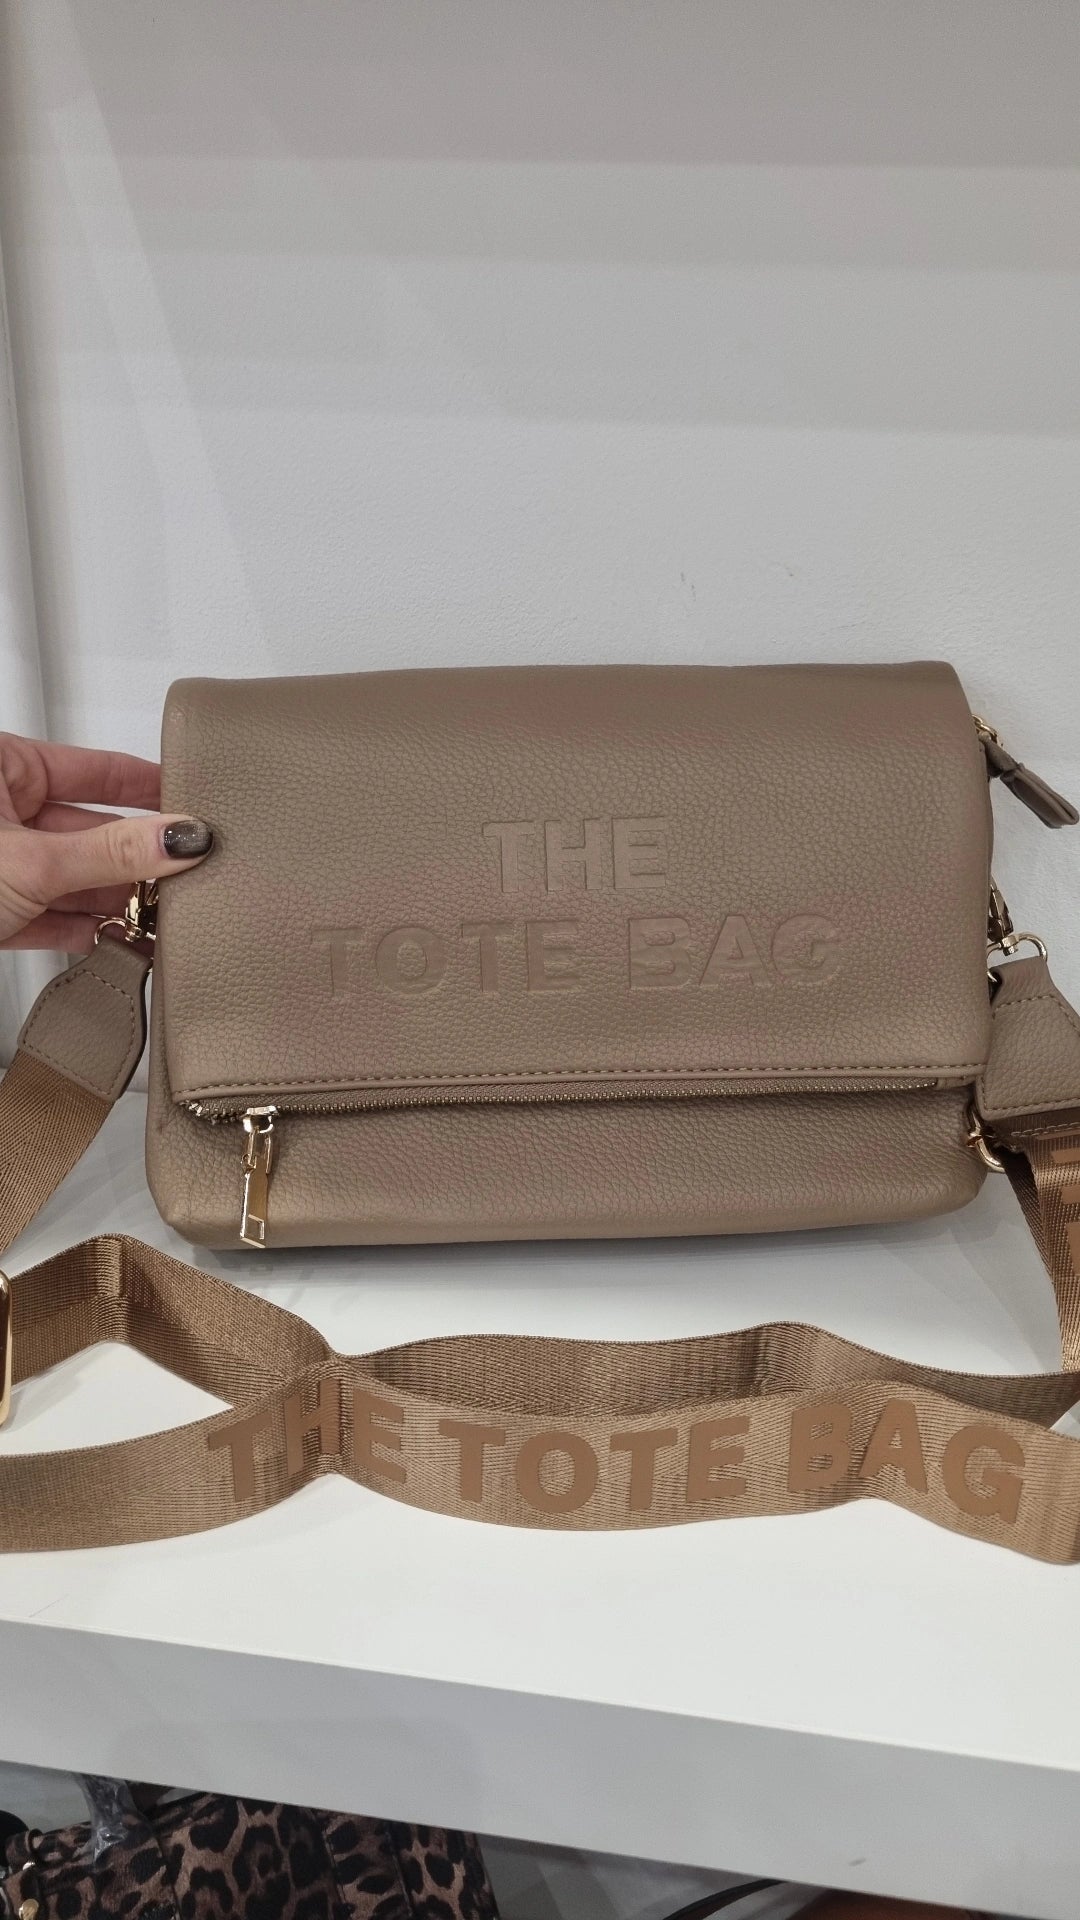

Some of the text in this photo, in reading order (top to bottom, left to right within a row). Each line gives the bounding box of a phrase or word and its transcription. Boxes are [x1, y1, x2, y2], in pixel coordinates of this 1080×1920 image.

[482, 815, 668, 893] THE
[310, 914, 842, 996] TOTE BAG
[207, 1377, 1027, 1525] THE TOTE BAG
